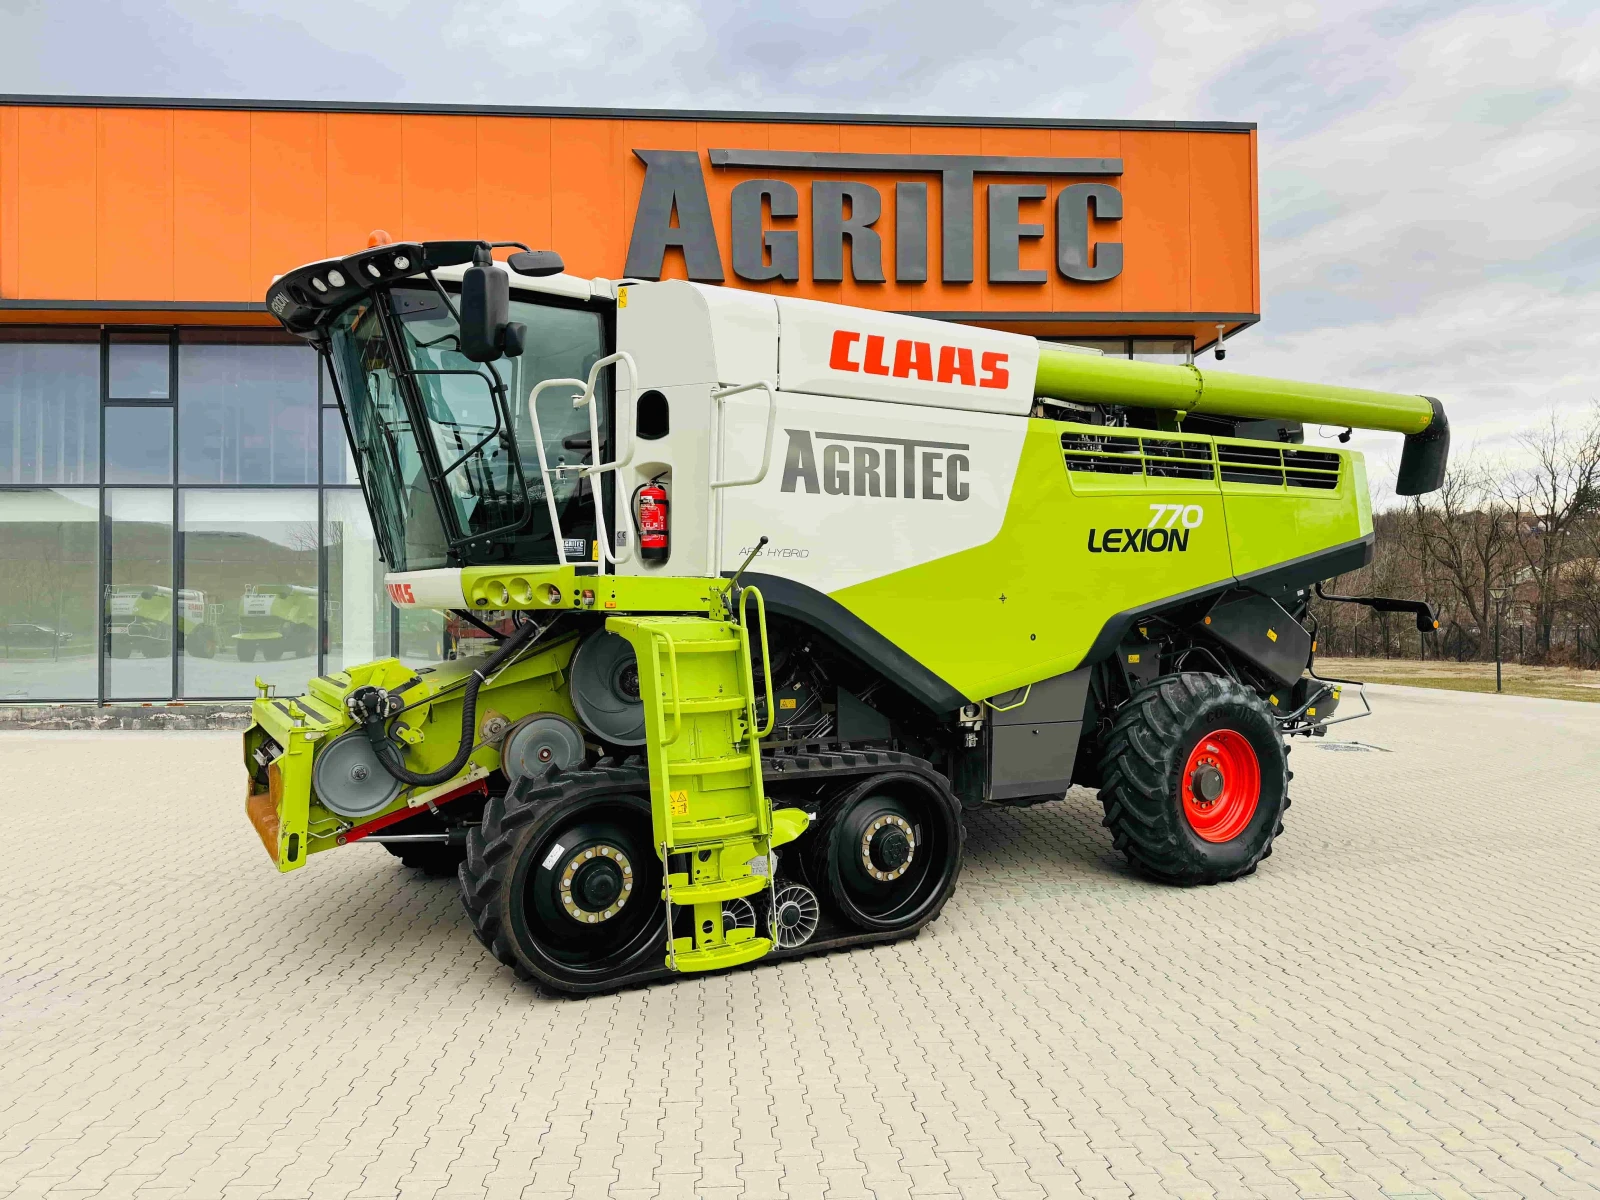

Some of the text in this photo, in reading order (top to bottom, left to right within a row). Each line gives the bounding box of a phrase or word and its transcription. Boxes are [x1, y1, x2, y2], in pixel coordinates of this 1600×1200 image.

[624, 148, 1123, 285] AGRITEC
[829, 330, 1009, 390] CLAAS
[780, 428, 970, 502] AGRITEC
[1147, 504, 1204, 528] 770
[767, 547, 810, 558] HYBRID
[1088, 528, 1190, 553] LEXION
